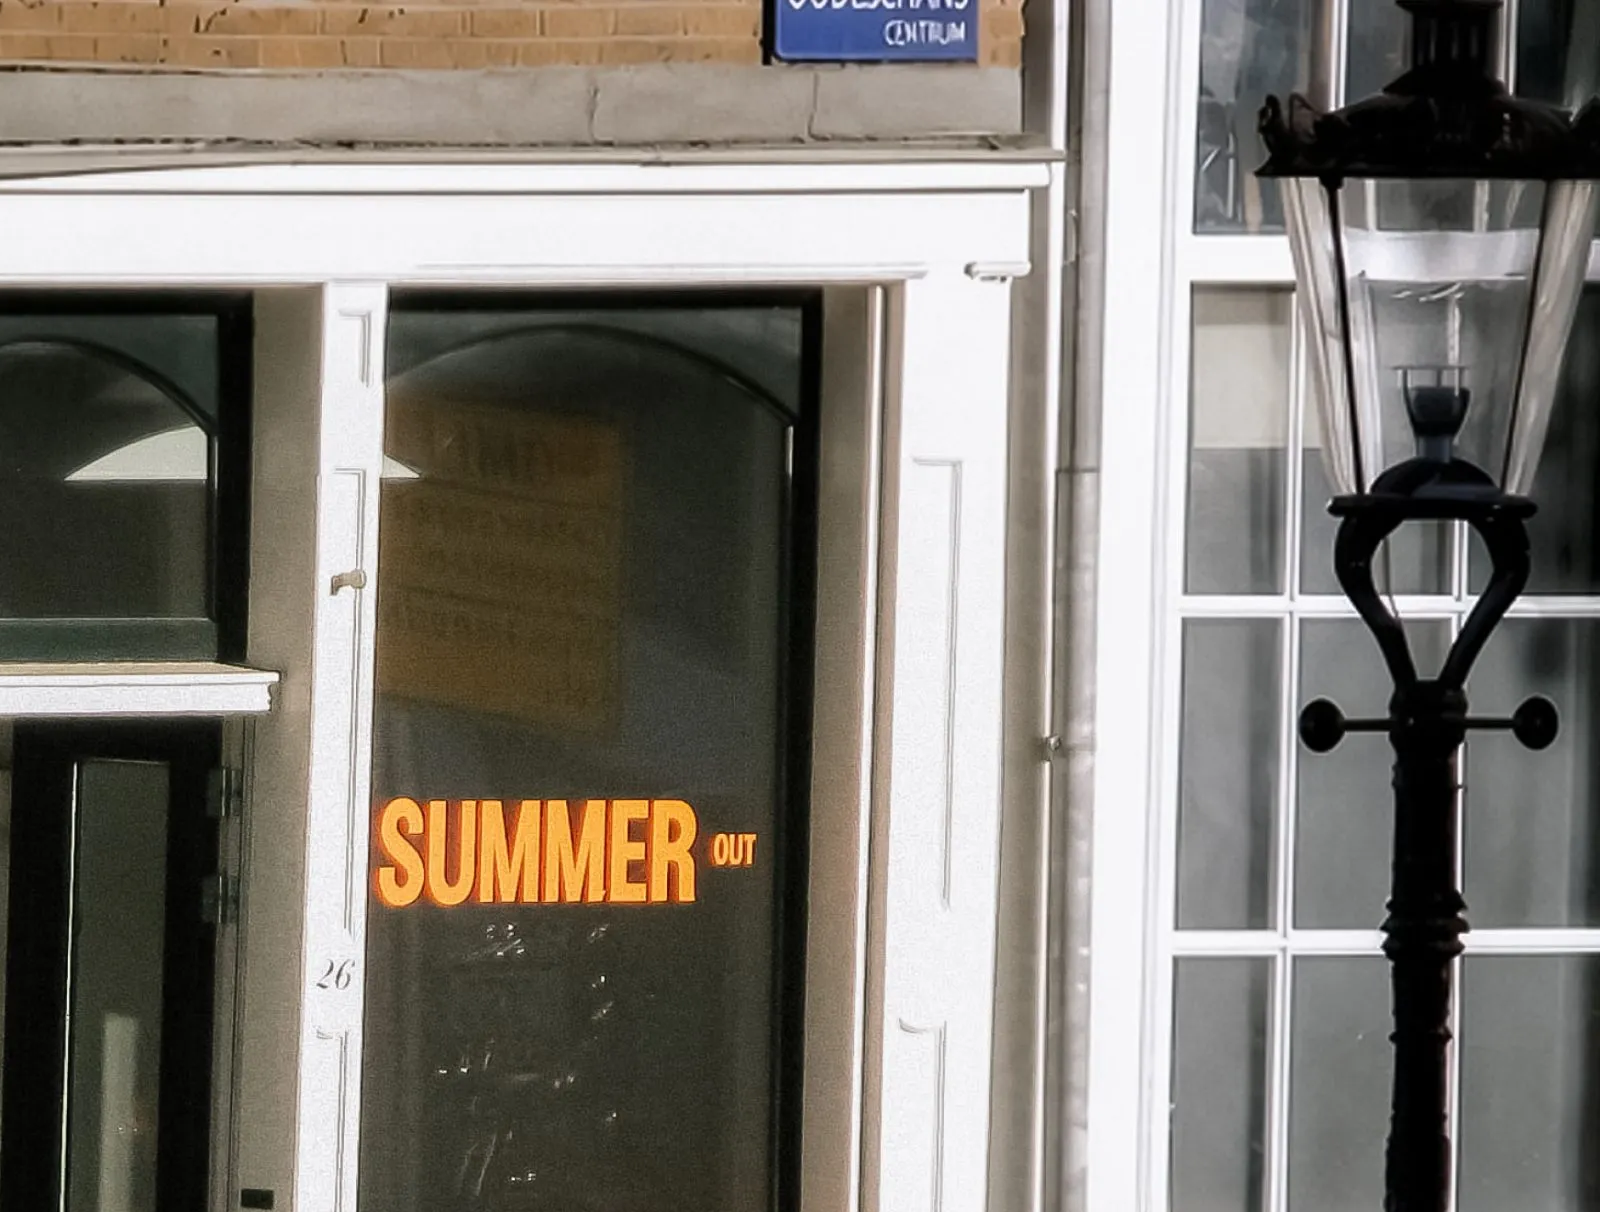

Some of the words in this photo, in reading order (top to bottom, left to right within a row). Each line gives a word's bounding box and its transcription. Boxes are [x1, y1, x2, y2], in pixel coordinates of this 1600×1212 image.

[884, 19, 965, 46] CENTRUM
[376, 797, 698, 907] SUMMER
[712, 833, 758, 866] OUT
[316, 958, 356, 990] 26
